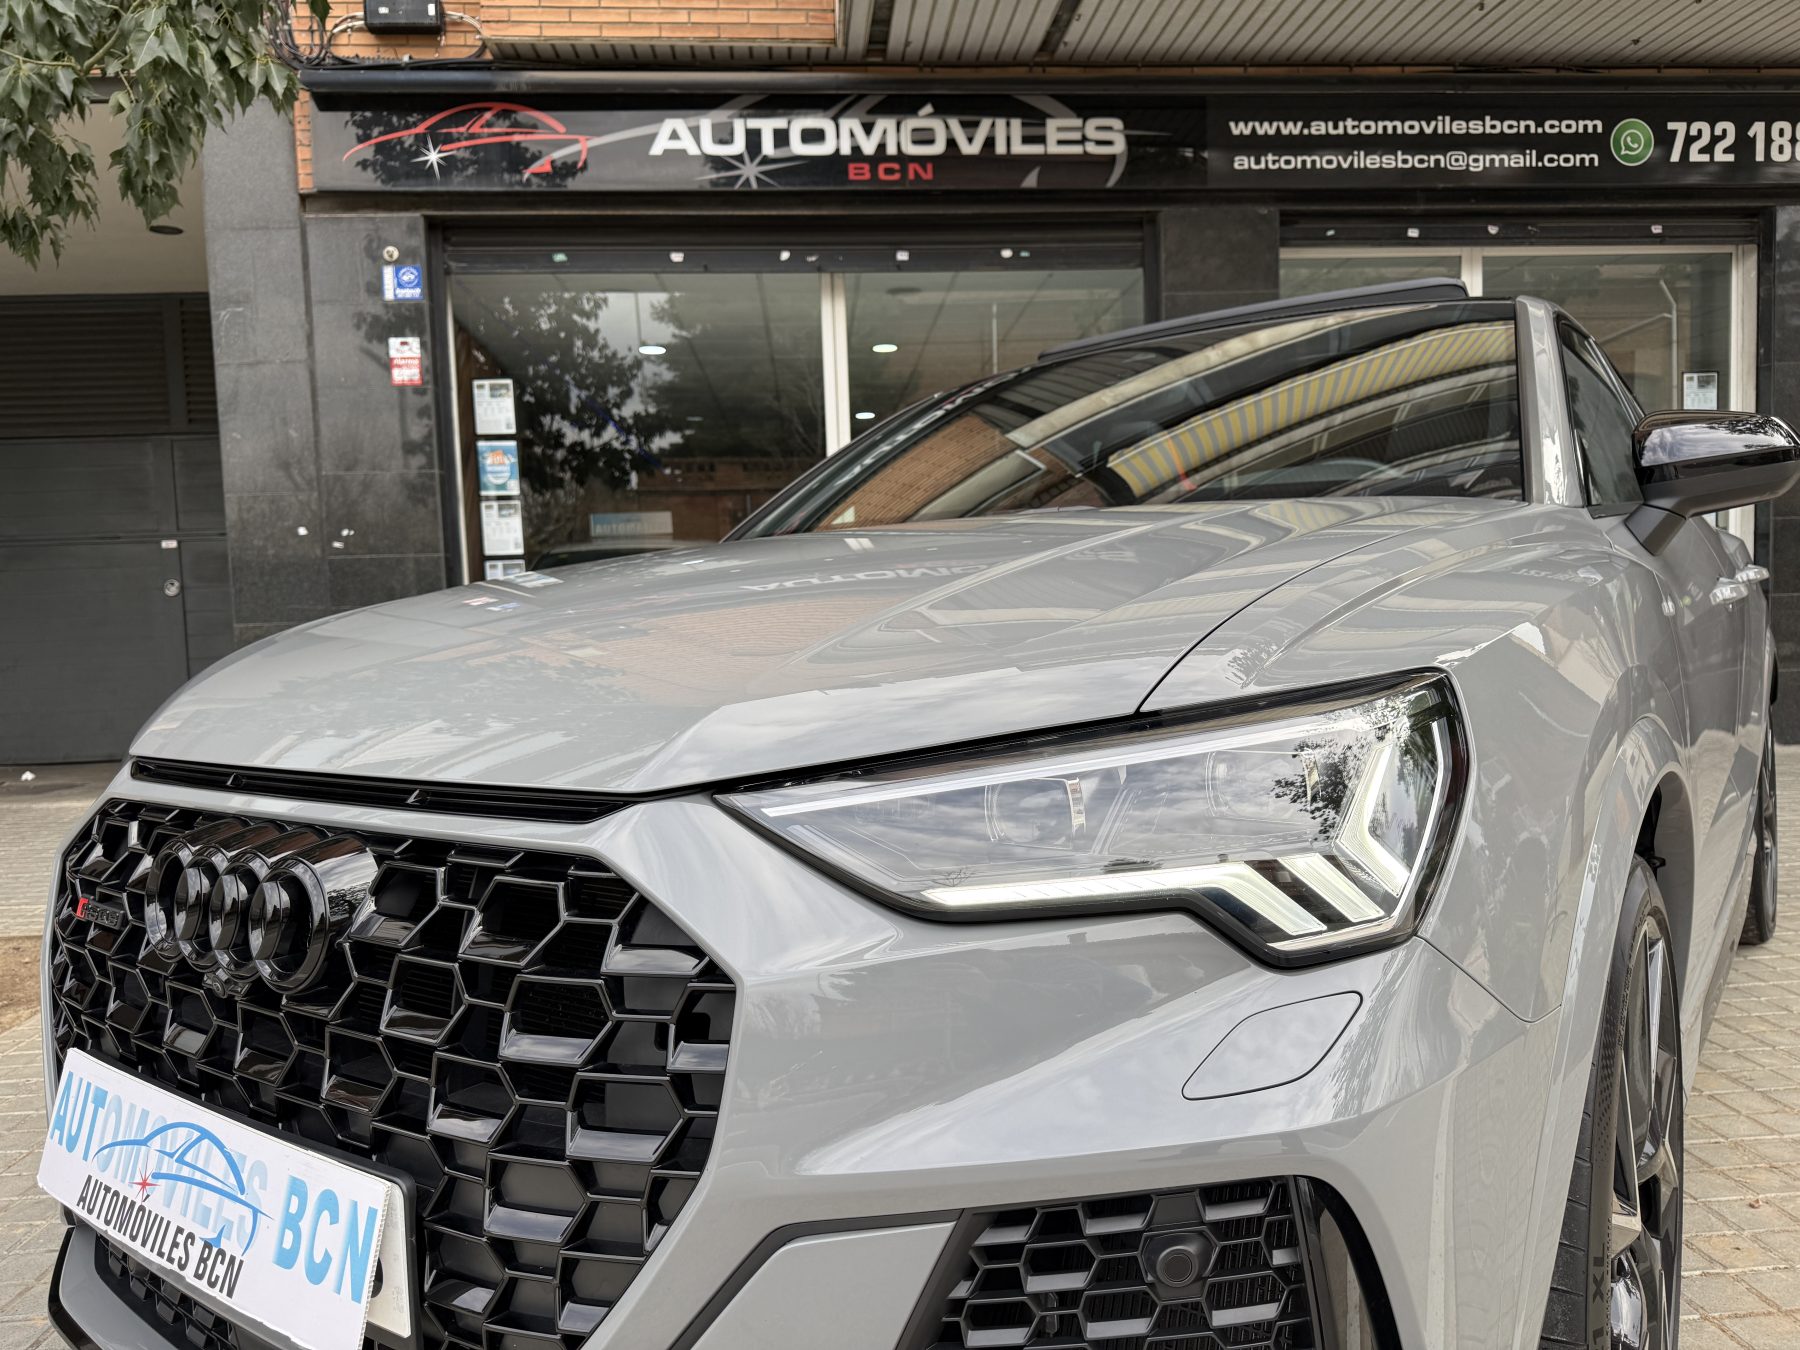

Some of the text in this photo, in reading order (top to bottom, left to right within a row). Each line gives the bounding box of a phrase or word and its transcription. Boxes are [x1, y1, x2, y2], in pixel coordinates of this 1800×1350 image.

[648, 103, 1127, 156] AUTOMÓVILES
[1228, 116, 1603, 136] www.automovilesbcn.com
[1666, 120, 1800, 163] 722 18
[847, 162, 934, 181] BCN
[1232, 150, 1599, 172] automovilesbcn@gmail.com
[76, 1174, 245, 1299] AUTOMÓVILES BCN
[272, 1175, 378, 1305] BCN
